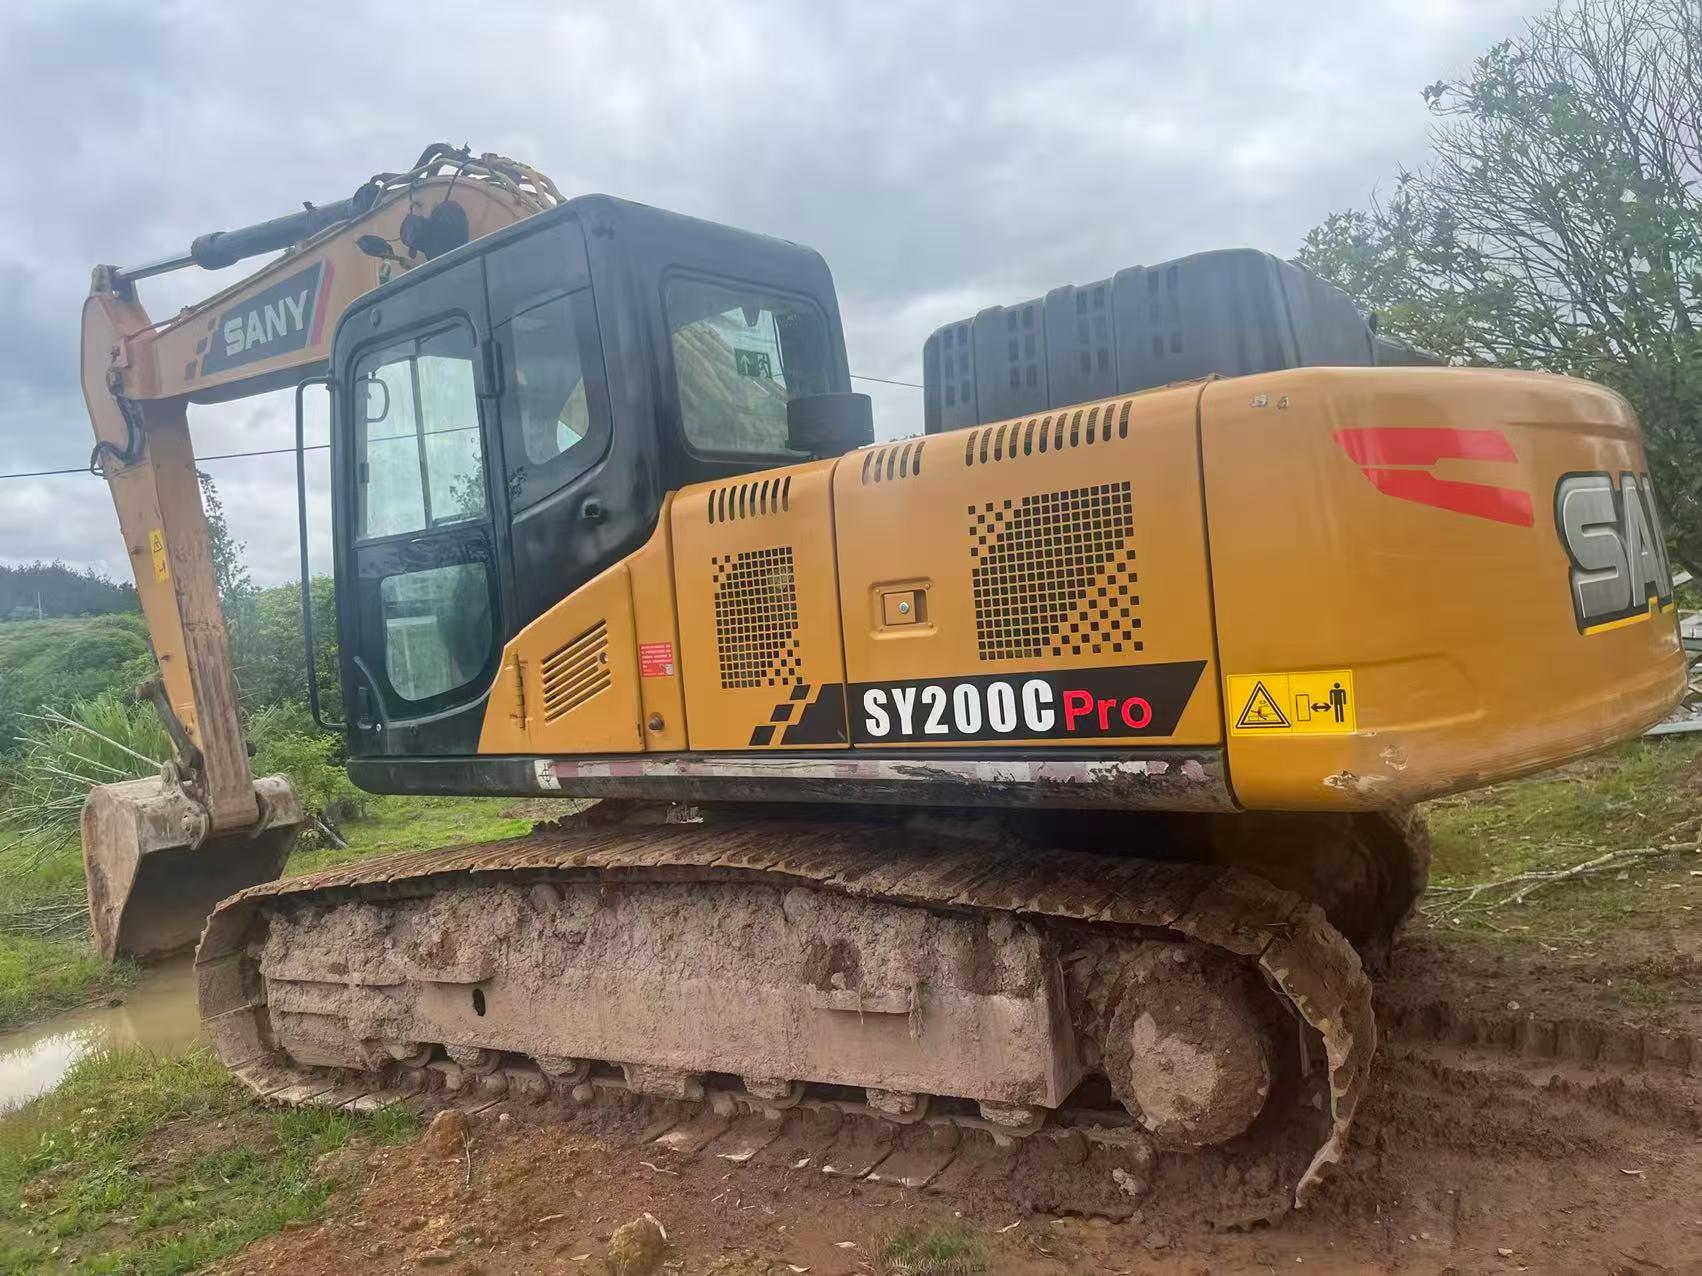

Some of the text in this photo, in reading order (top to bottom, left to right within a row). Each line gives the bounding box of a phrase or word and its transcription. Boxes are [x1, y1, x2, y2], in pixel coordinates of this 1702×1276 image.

[224, 289, 308, 356] SANY
[863, 679, 1153, 737] SY200C Pro
